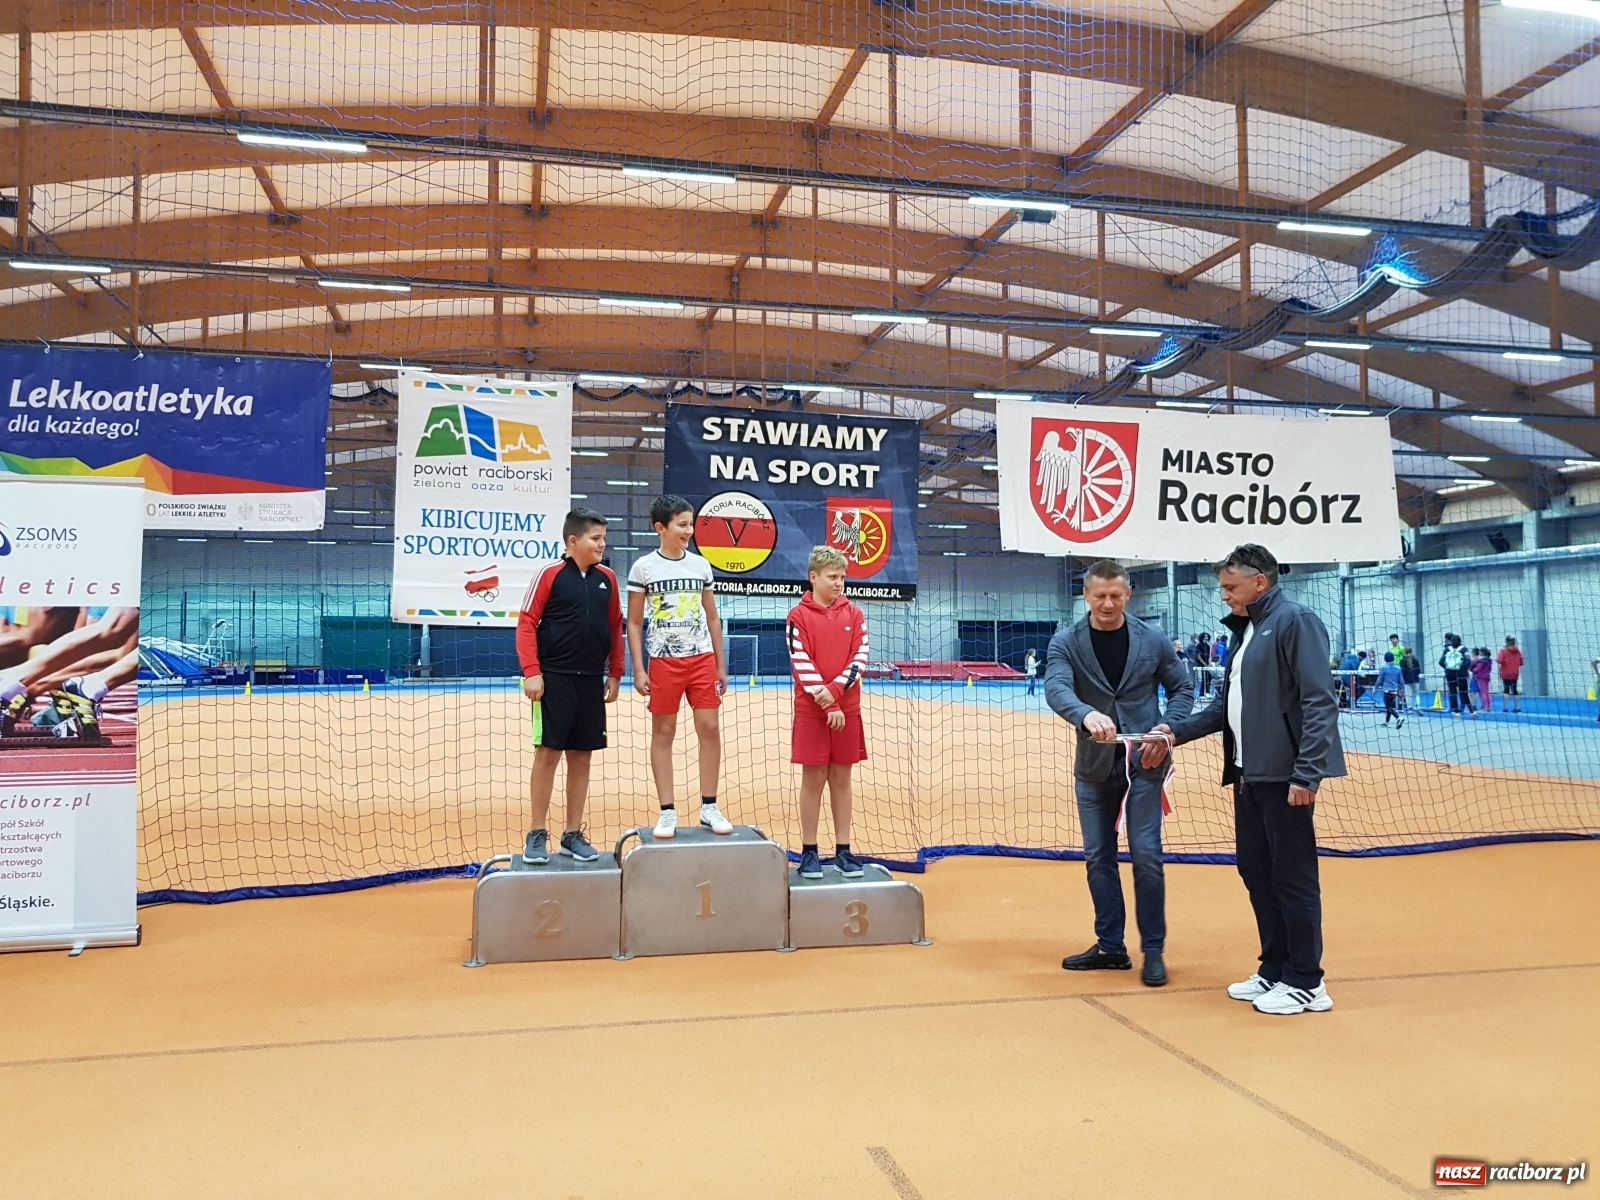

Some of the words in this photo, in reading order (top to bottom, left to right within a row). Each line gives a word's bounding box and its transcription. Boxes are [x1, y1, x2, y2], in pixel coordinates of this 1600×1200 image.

[9, 379, 253, 420] Lekkoatletyka
[8, 414, 39, 432] dla
[45, 415, 140, 440] każdego!
[702, 416, 888, 452] STAWIAMY
[414, 462, 468, 477] powiat
[479, 465, 552, 481] raciborski
[709, 455, 759, 482] NA
[768, 460, 880, 488] SPORT
[1162, 448, 1274, 477] MIASTO
[413, 477, 461, 488] zielona
[471, 482, 504, 491] oaza
[513, 483, 552, 493] kultur
[197, 503, 227, 511] ZWIĄZKU
[701, 500, 734, 527] VICTORIA
[735, 500, 770, 531] RACIBÓRZ
[1158, 479, 1362, 526] Racibórz
[16, 527, 78, 541] ZSOMS
[421, 508, 546, 535] KIBICUJEMY
[721, 518, 750, 547] V
[403, 535, 560, 559] SPORTOWCOM
[725, 562, 746, 570] 1970
[0, 820, 16, 831] pół
[18, 819, 45, 828] Szkół
[0, 831, 62, 842] kształcących
[0, 858, 43, 867] rtowego
[0, 871, 43, 879] aciborzu
[0, 895, 55, 912] Śląskie.
[695, 880, 717, 918] 1
[533, 899, 564, 940] 2
[843, 899, 870, 938] 3
